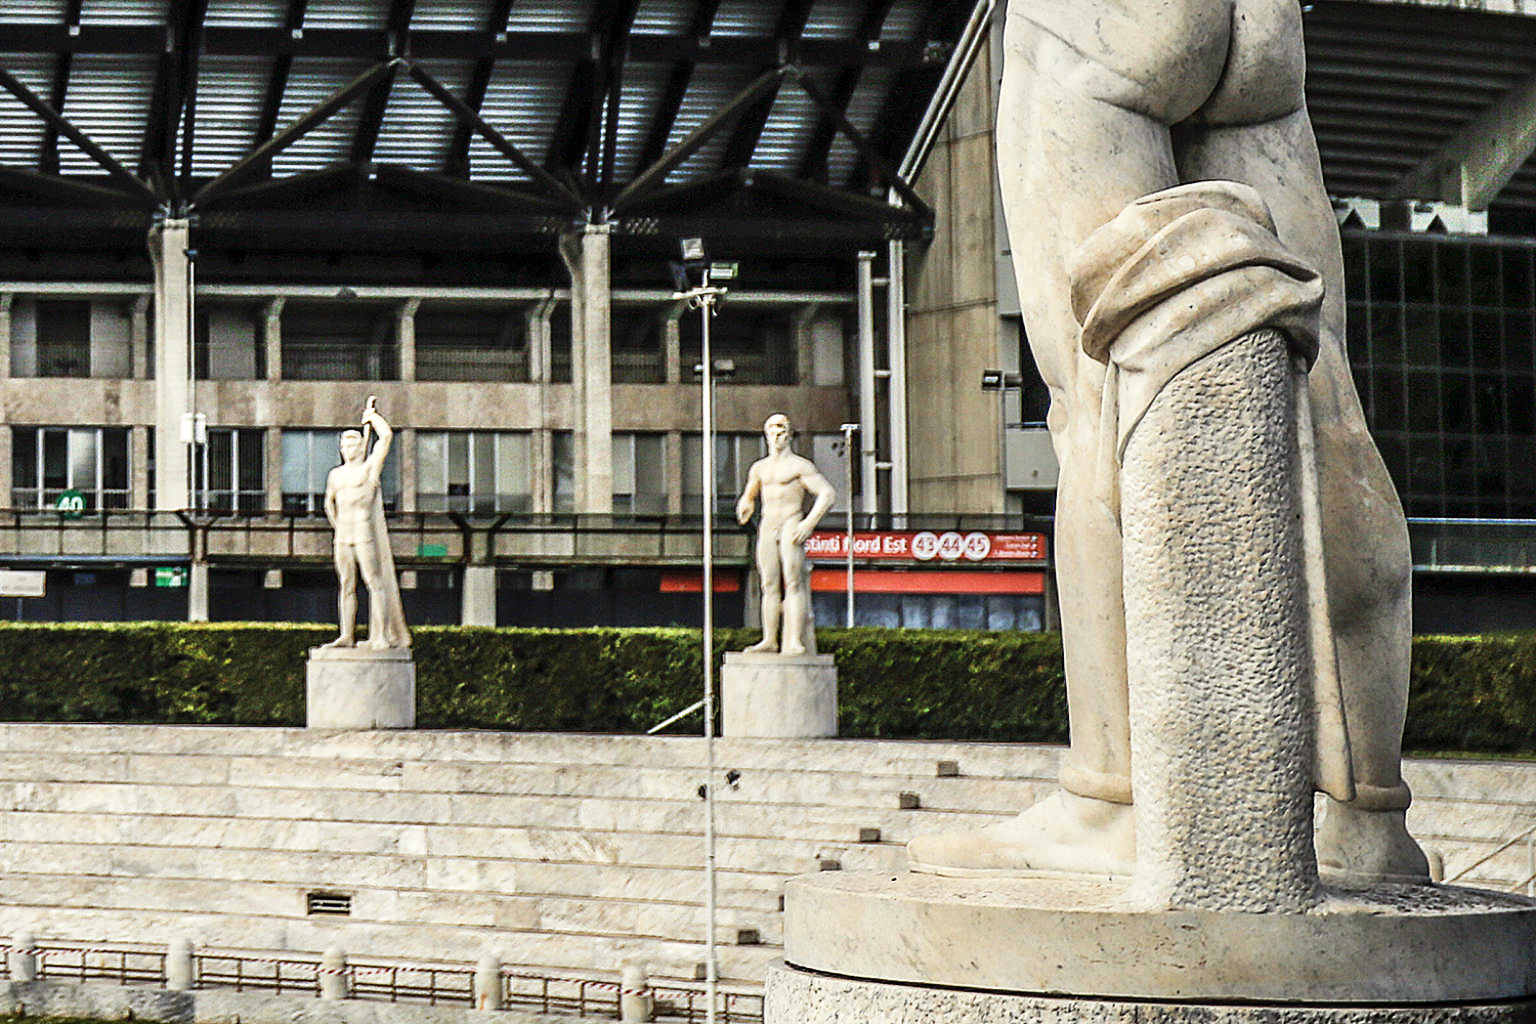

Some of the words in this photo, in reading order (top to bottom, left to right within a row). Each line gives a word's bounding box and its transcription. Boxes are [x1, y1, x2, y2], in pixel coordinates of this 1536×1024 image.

[804, 535, 840, 552] stinti
[883, 536, 908, 553] Est
[916, 536, 935, 552] 43
[942, 536, 960, 552] 44
[967, 536, 986, 552] 45
